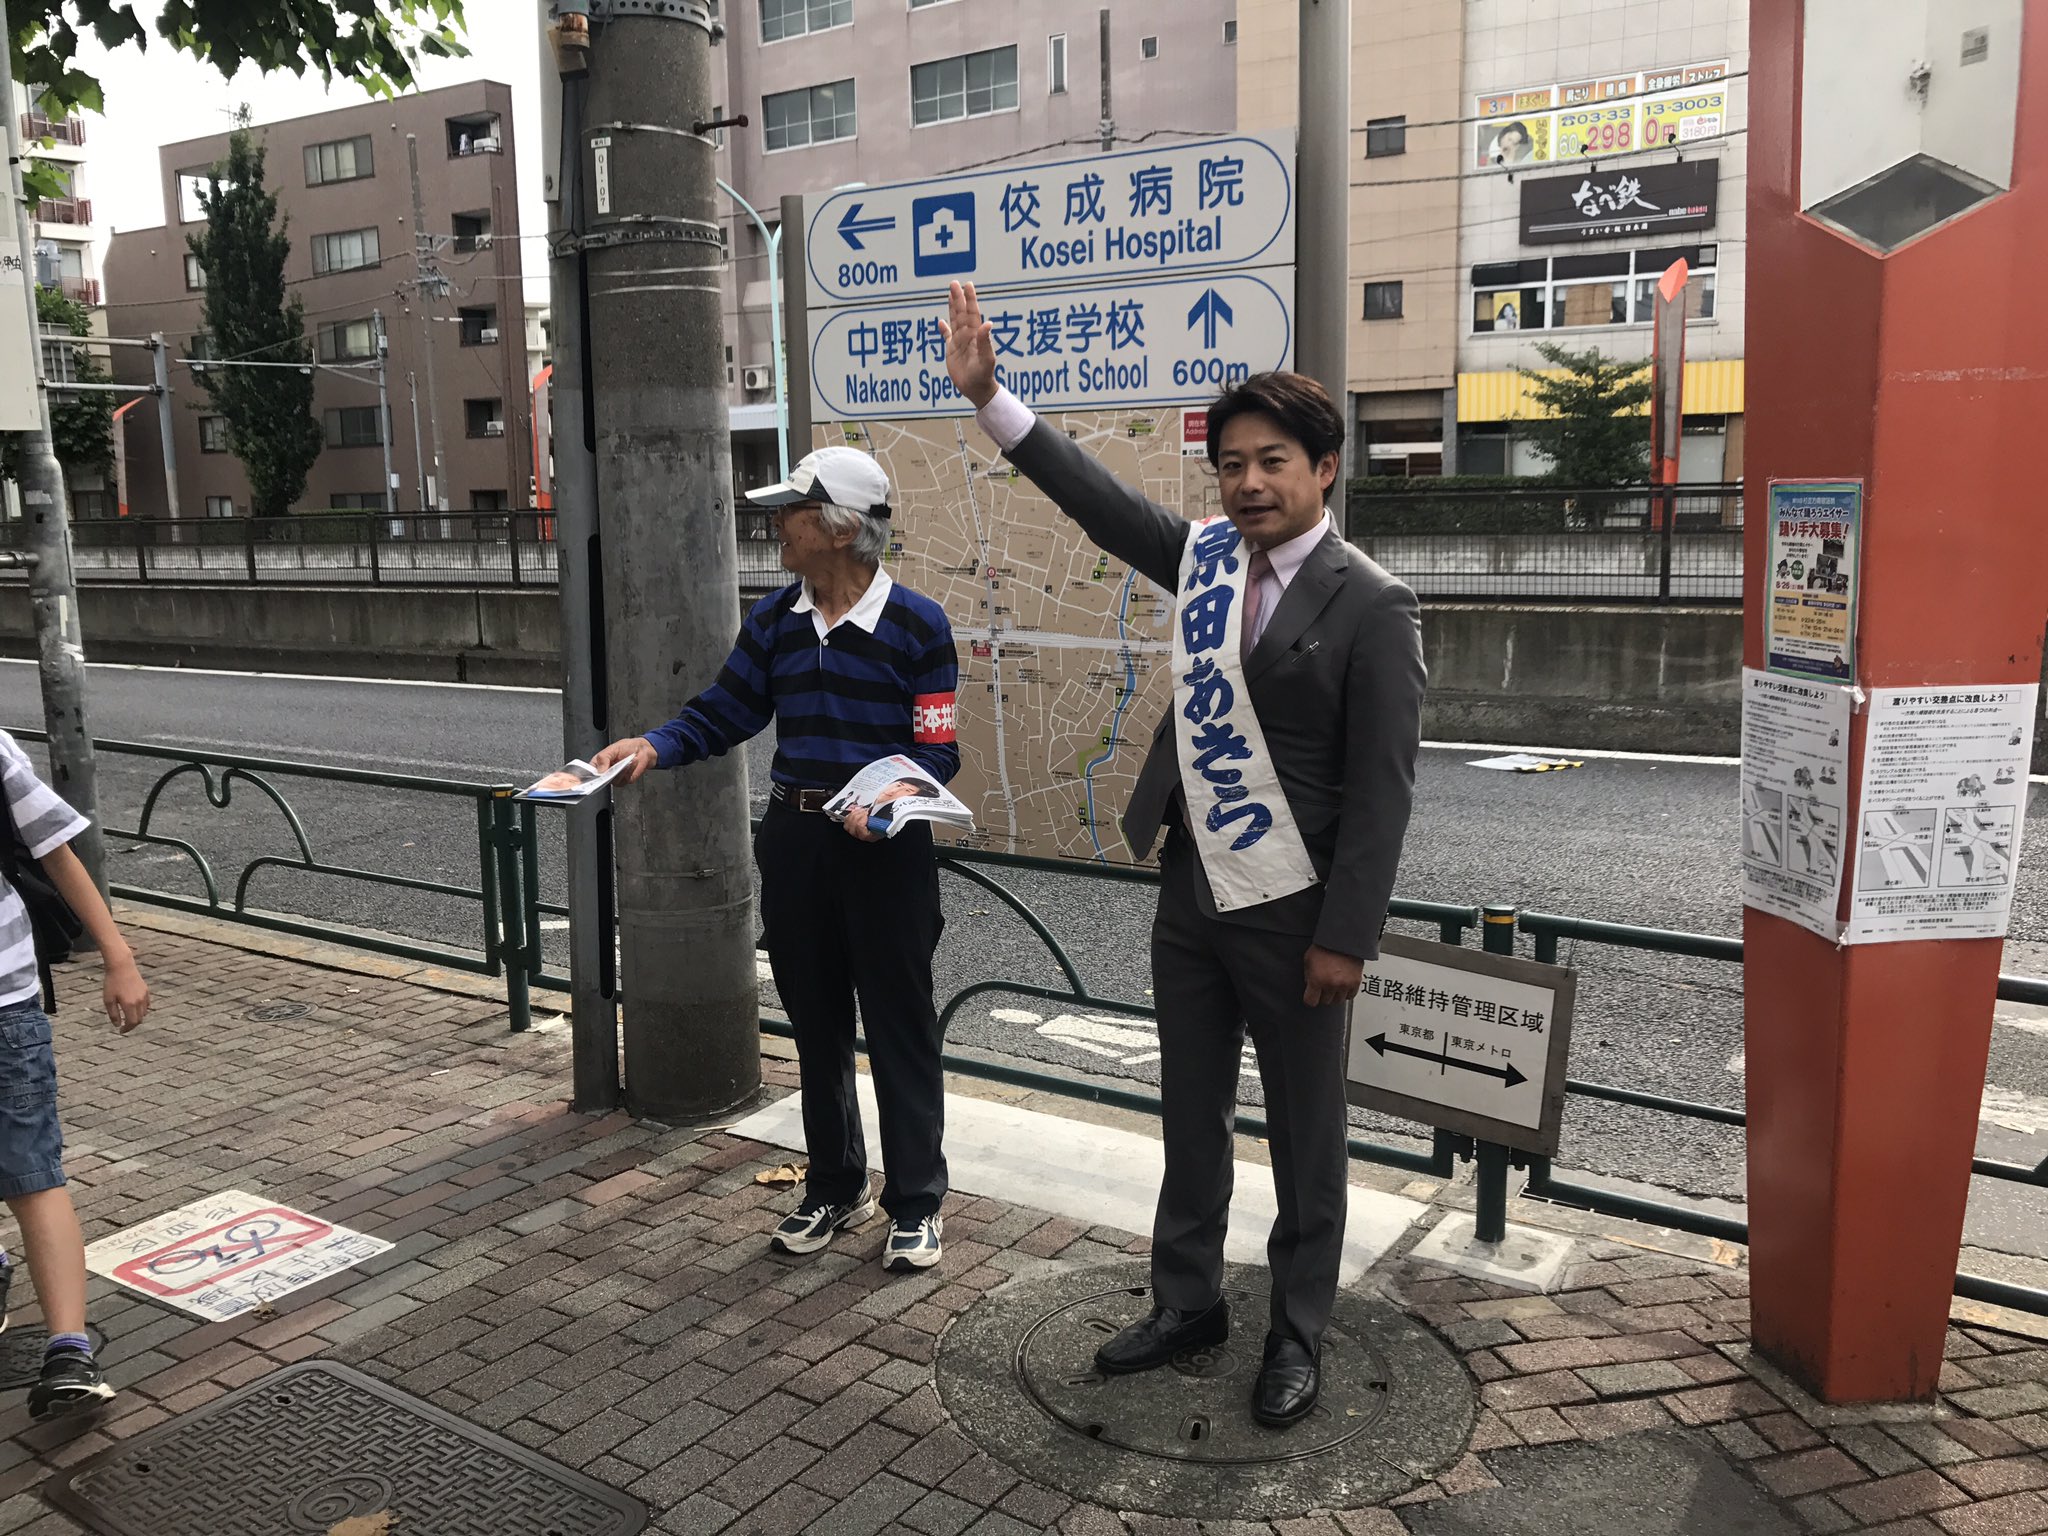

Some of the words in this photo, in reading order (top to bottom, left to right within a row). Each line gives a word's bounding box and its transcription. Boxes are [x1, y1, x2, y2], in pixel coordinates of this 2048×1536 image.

[999, 155, 1245, 234] 佼成病院
[1020, 231, 1095, 271] Kosei
[1105, 215, 1222, 264] Hospital
[837, 261, 898, 288] 800m
[847, 298, 1145, 370] 中野特支援学校
[846, 372, 912, 405] Nakano
[993, 360, 1070, 402] Support
[1078, 355, 1149, 392] School
[1172, 357, 1249, 387] 600m
[1183, 520, 1273, 852] 原田あきら
[1361, 973, 1545, 1034] 道路維持管理区域
[1399, 1023, 1435, 1041] 東京都
[1451, 1035, 1512, 1059] 東京メトロ
[120, 1205, 240, 1255] 杉並区
